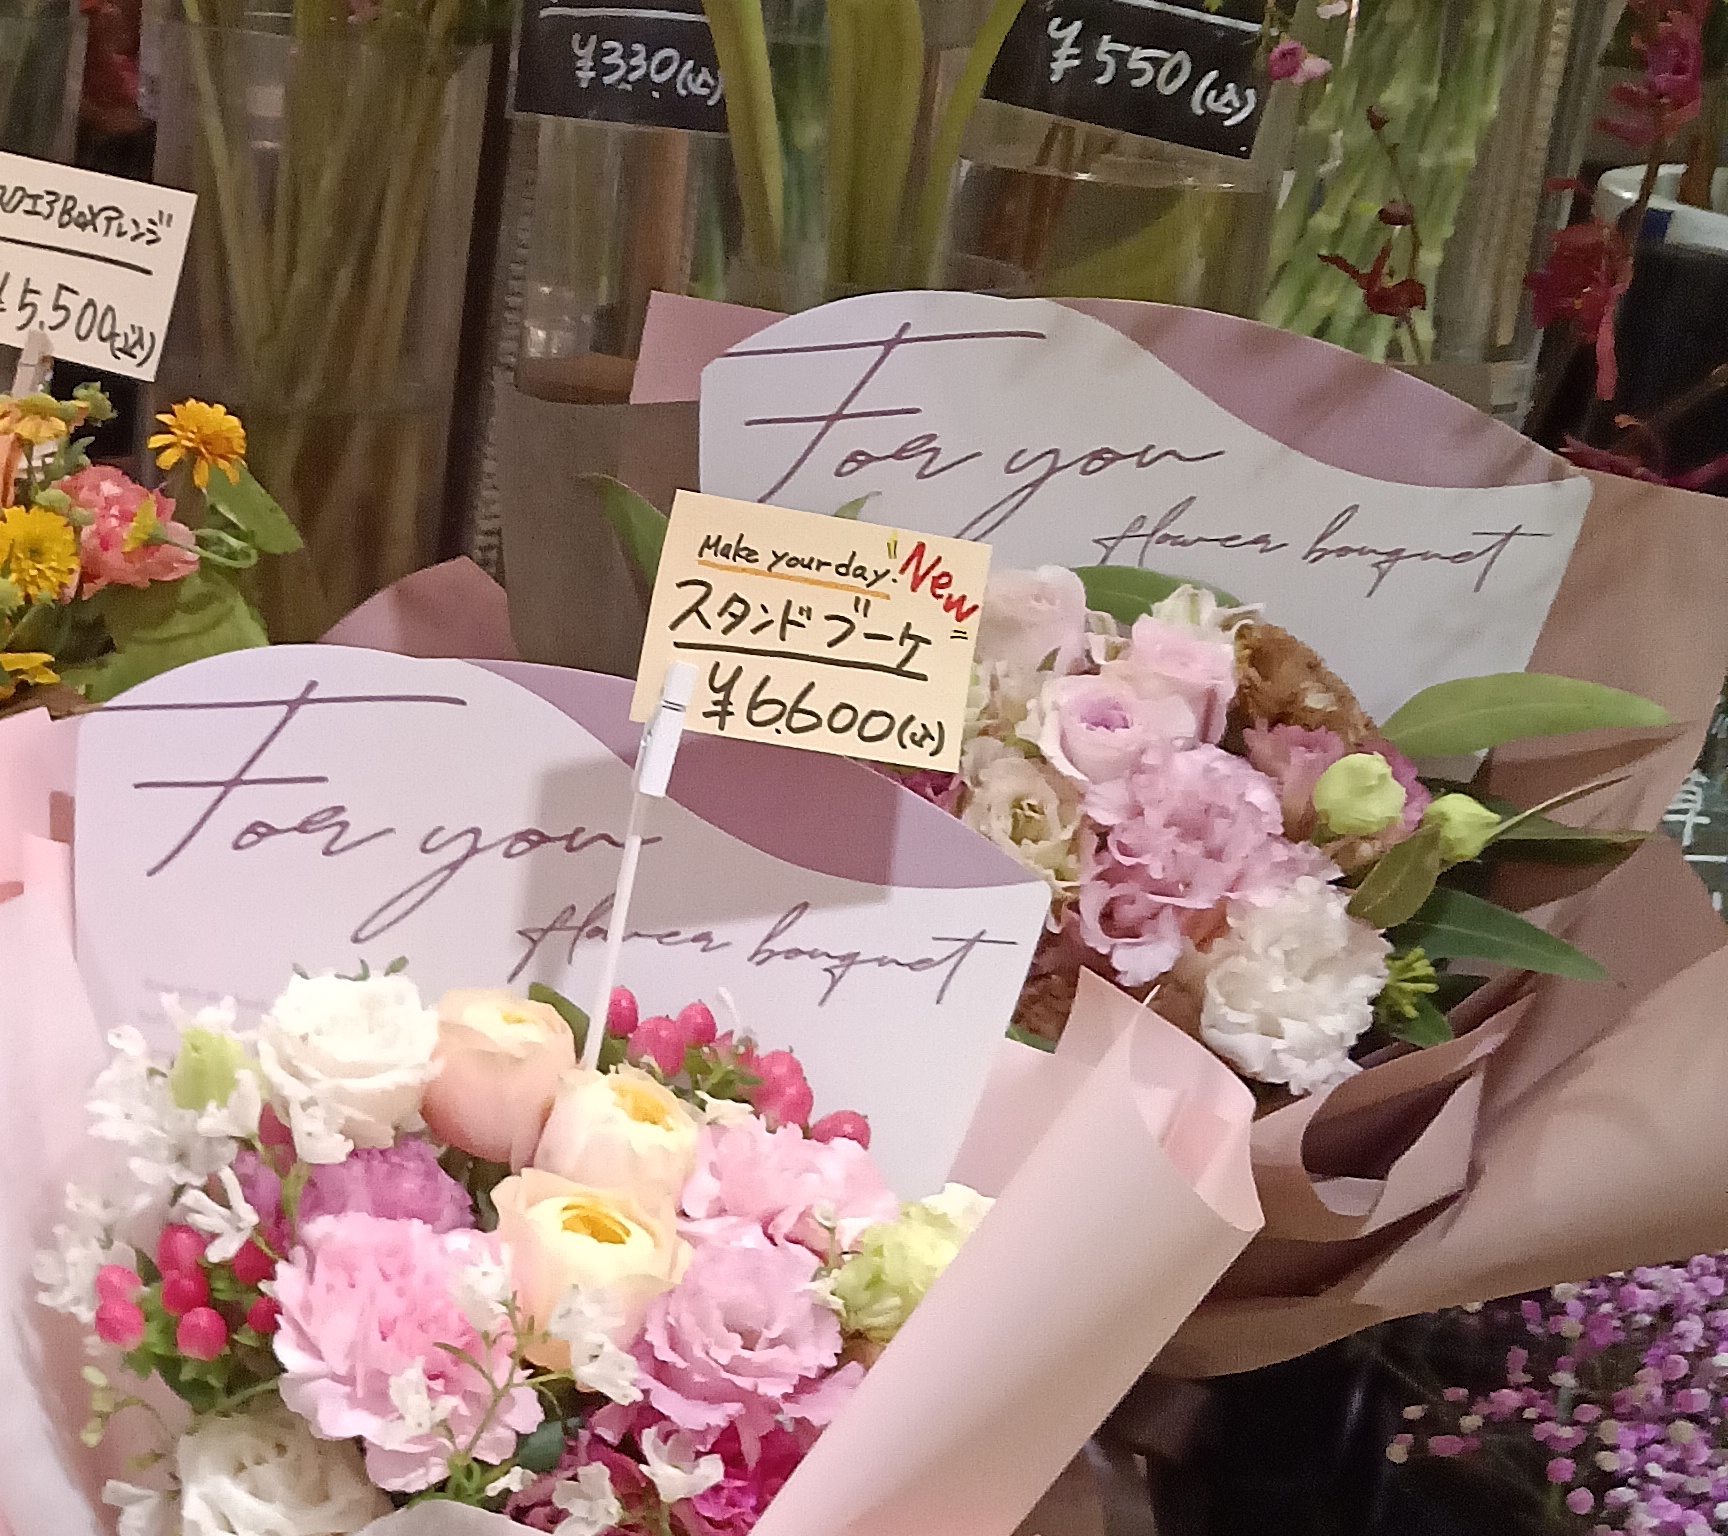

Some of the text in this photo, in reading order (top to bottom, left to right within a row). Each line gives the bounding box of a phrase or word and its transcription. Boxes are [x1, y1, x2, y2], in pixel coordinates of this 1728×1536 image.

[952, 440, 1227, 543] you
[697, 532, 760, 563] Make
[898, 540, 980, 624] New
[1092, 495, 1553, 599] flower bouquet
[100, 678, 666, 946] For you
[747, 899, 1019, 1008] bouquet
